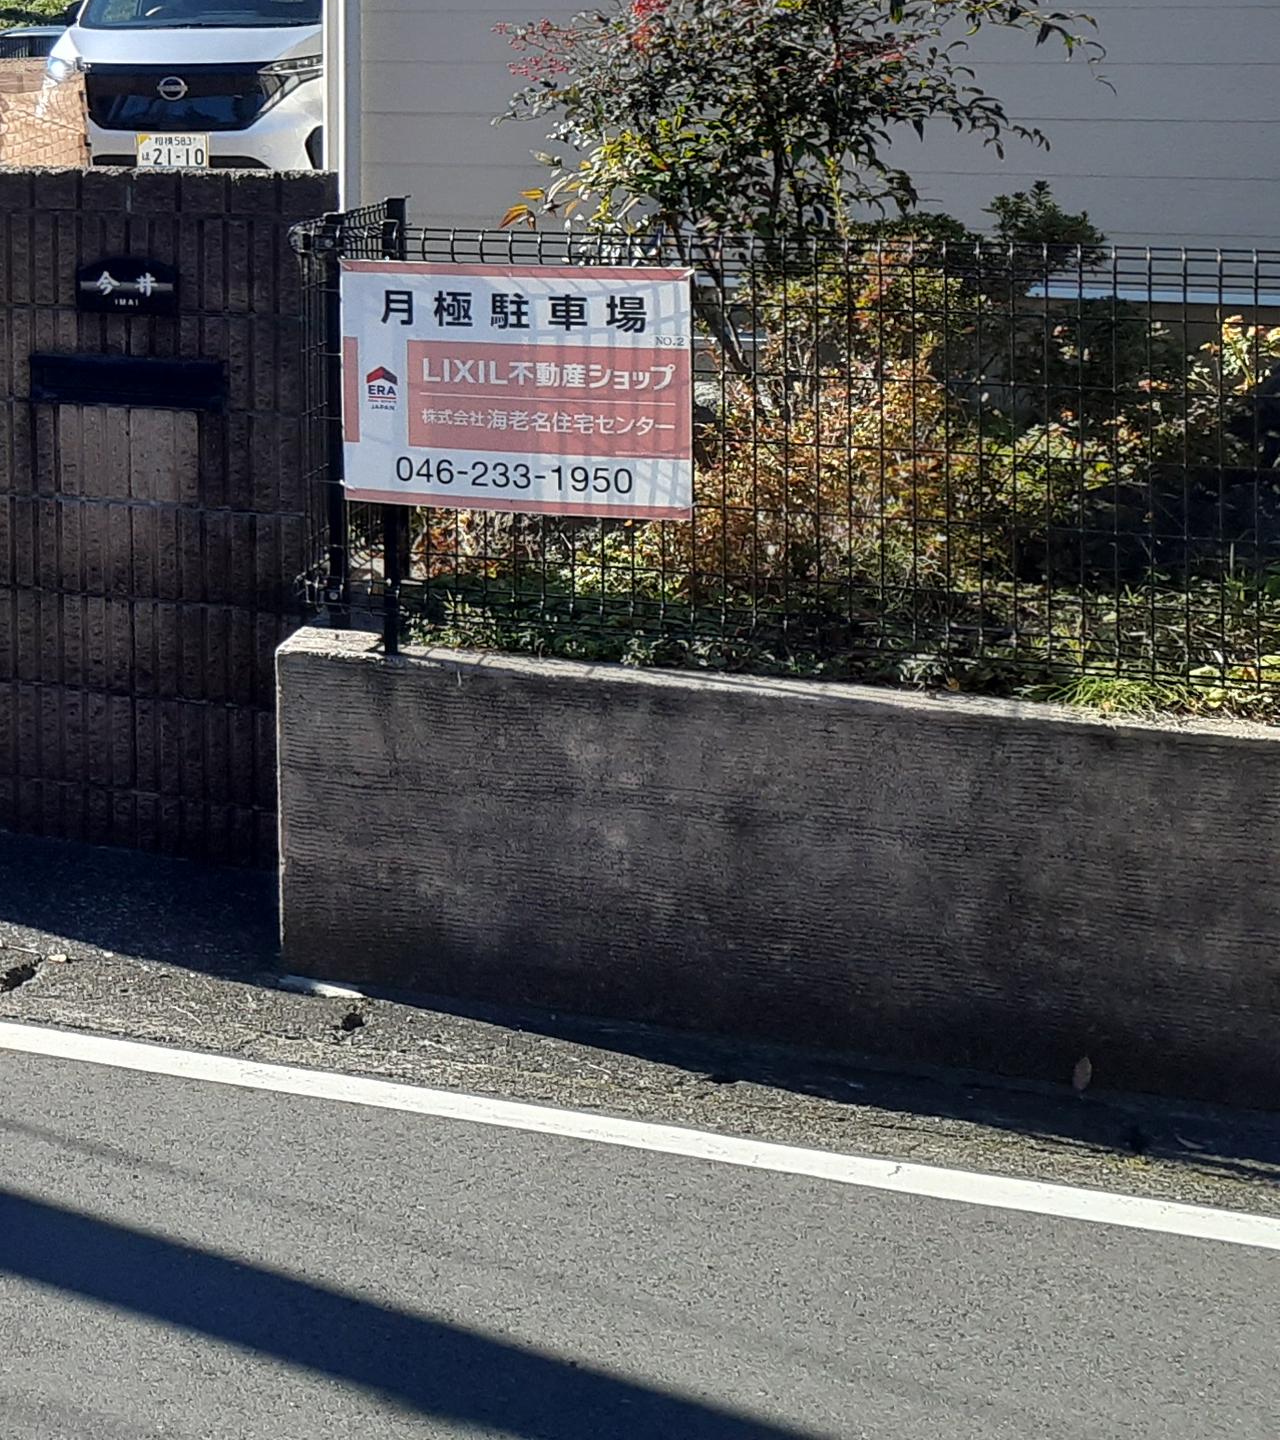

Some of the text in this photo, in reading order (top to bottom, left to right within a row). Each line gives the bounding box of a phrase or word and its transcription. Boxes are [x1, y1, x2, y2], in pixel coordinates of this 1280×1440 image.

[153, 148, 204, 165] 21-10
[95, 270, 159, 297] 今井
[114, 298, 139, 306] IMAI
[380, 289, 647, 333] 月極駐車場
[655, 336, 684, 346] NO.2
[422, 357, 675, 391] LIXIL不動産ショップ
[368, 385, 396, 395] ERA
[395, 456, 633, 494] 046-233-1950
